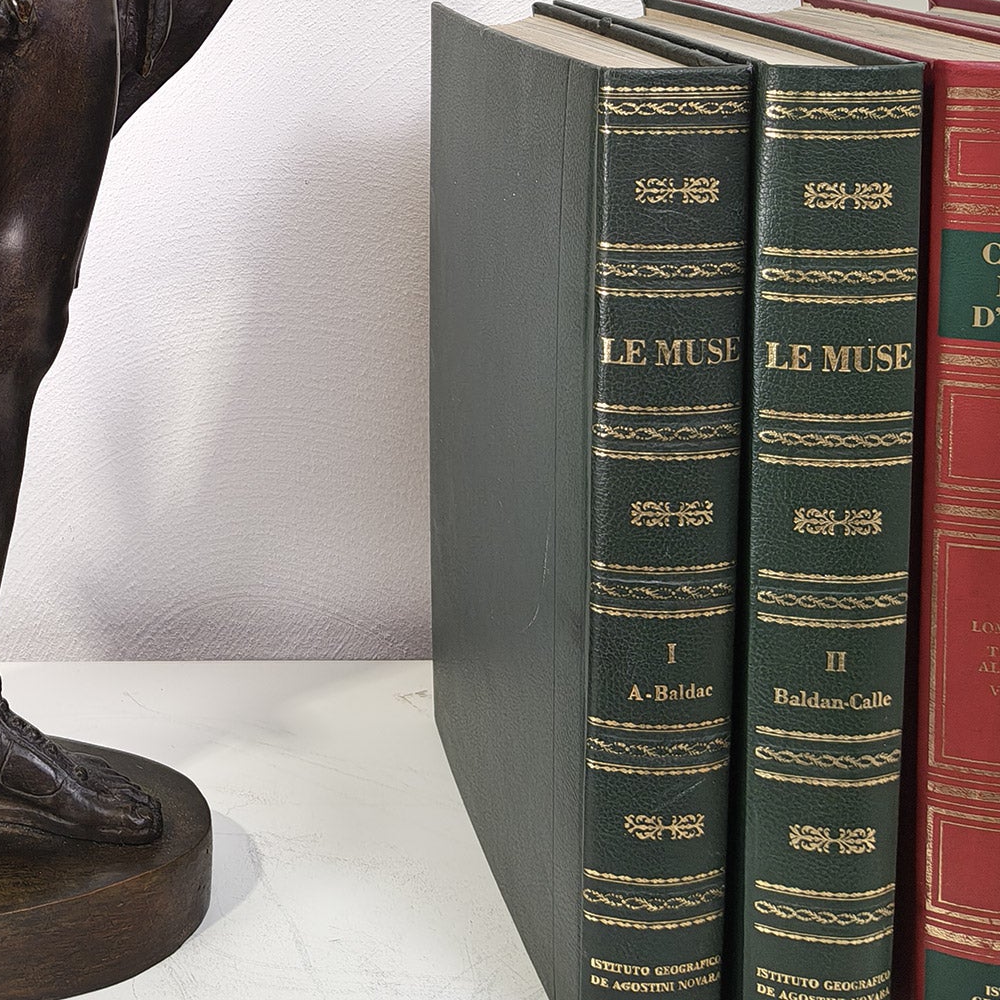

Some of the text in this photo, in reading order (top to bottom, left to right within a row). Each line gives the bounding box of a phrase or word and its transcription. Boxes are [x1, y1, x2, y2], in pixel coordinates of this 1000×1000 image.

[600, 336, 740, 366] LE MUSE
[765, 341, 913, 372] LE MUSE
[667, 643, 677, 664] I
[825, 651, 847, 673] II
[590, 954, 721, 976] ISTITUTO GEOGRAFICO
[590, 971, 721, 993] DE AGOSTINI NOVARA
[756, 967, 891, 992] ISTITUTO GEOGRAFICO
[756, 983, 775, 998] DE
